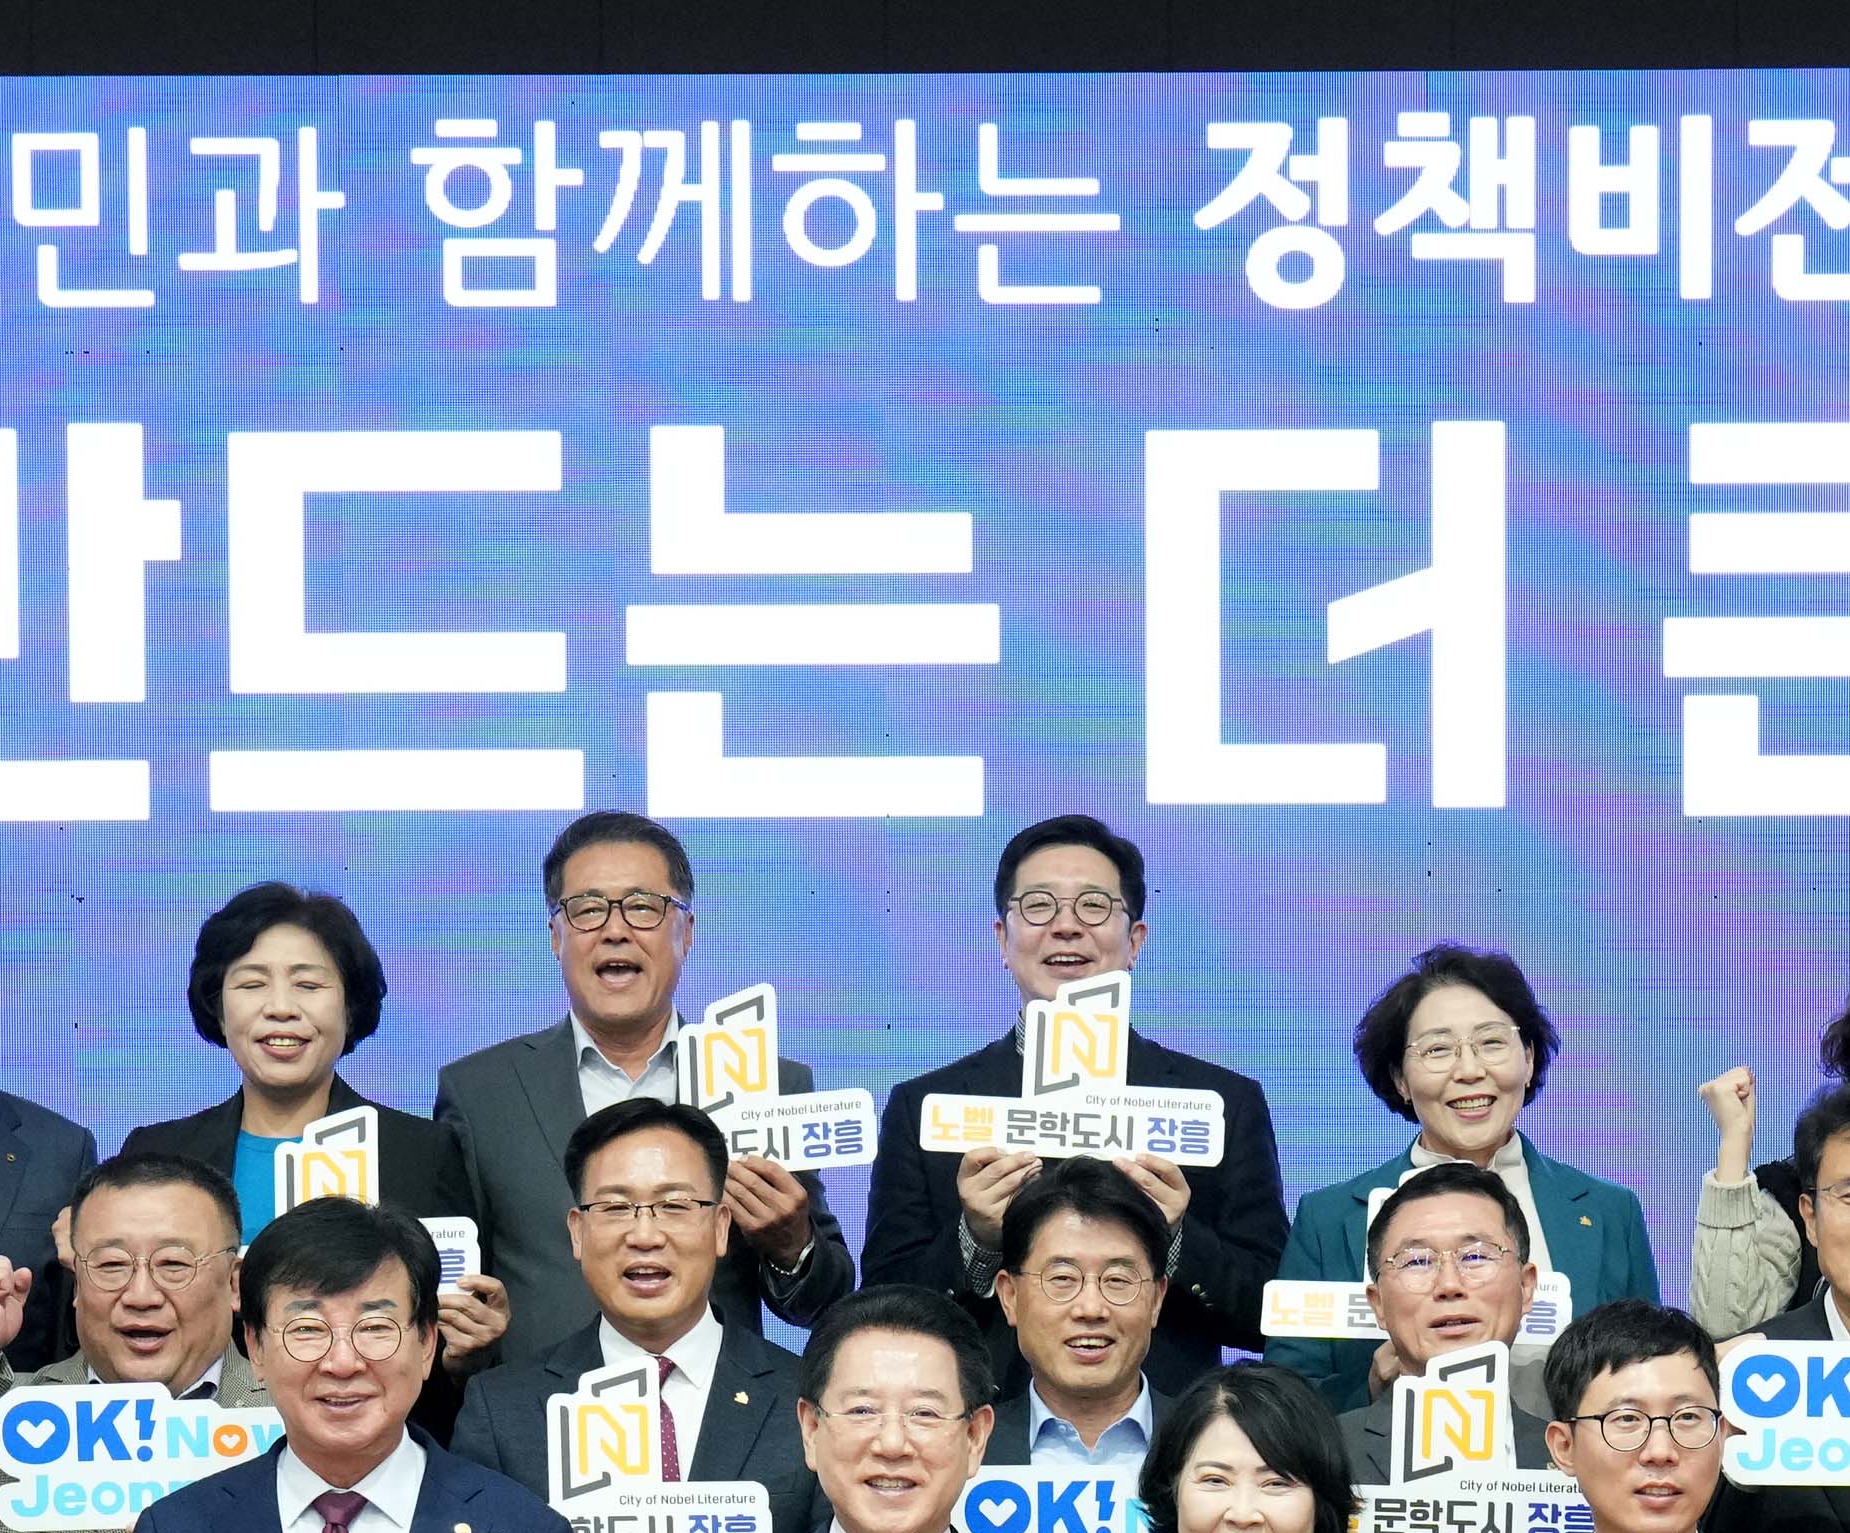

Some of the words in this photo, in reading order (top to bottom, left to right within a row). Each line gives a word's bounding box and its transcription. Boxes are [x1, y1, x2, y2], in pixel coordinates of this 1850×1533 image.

[411, 119, 1120, 307] 함께하는
[1145, 421, 1505, 807] 더
[741, 1110, 761, 1121] City
[764, 1108, 774, 1118] of
[777, 1104, 807, 1117] Nobel
[810, 1101, 861, 1113] Literature
[1086, 1095, 1106, 1107] City
[1110, 1096, 1120, 1105] of
[1124, 1097, 1154, 1107] Nobel
[1158, 1099, 1211, 1110] Literature
[721, 1126, 789, 1160] 도시
[802, 1119, 863, 1158] 장흥
[932, 1106, 993, 1142] 노벨
[1006, 1109, 1134, 1150] 문학도시
[1147, 1117, 1210, 1154] 장흥
[432, 1229, 465, 1239] rature
[439, 1248, 465, 1283] 흥
[1271, 1291, 1334, 1326] 노벨
[1518, 1300, 1557, 1334] 흥
[2, 1399, 156, 1465] OK!
[619, 1495, 642, 1508] City
[646, 1494, 657, 1504] of
[661, 1494, 694, 1504] Nobel
[698, 1493, 756, 1504] Literature
[1460, 1480, 1483, 1493] City
[1486, 1480, 1498, 1491] of
[1502, 1481, 1536, 1493] Nobel
